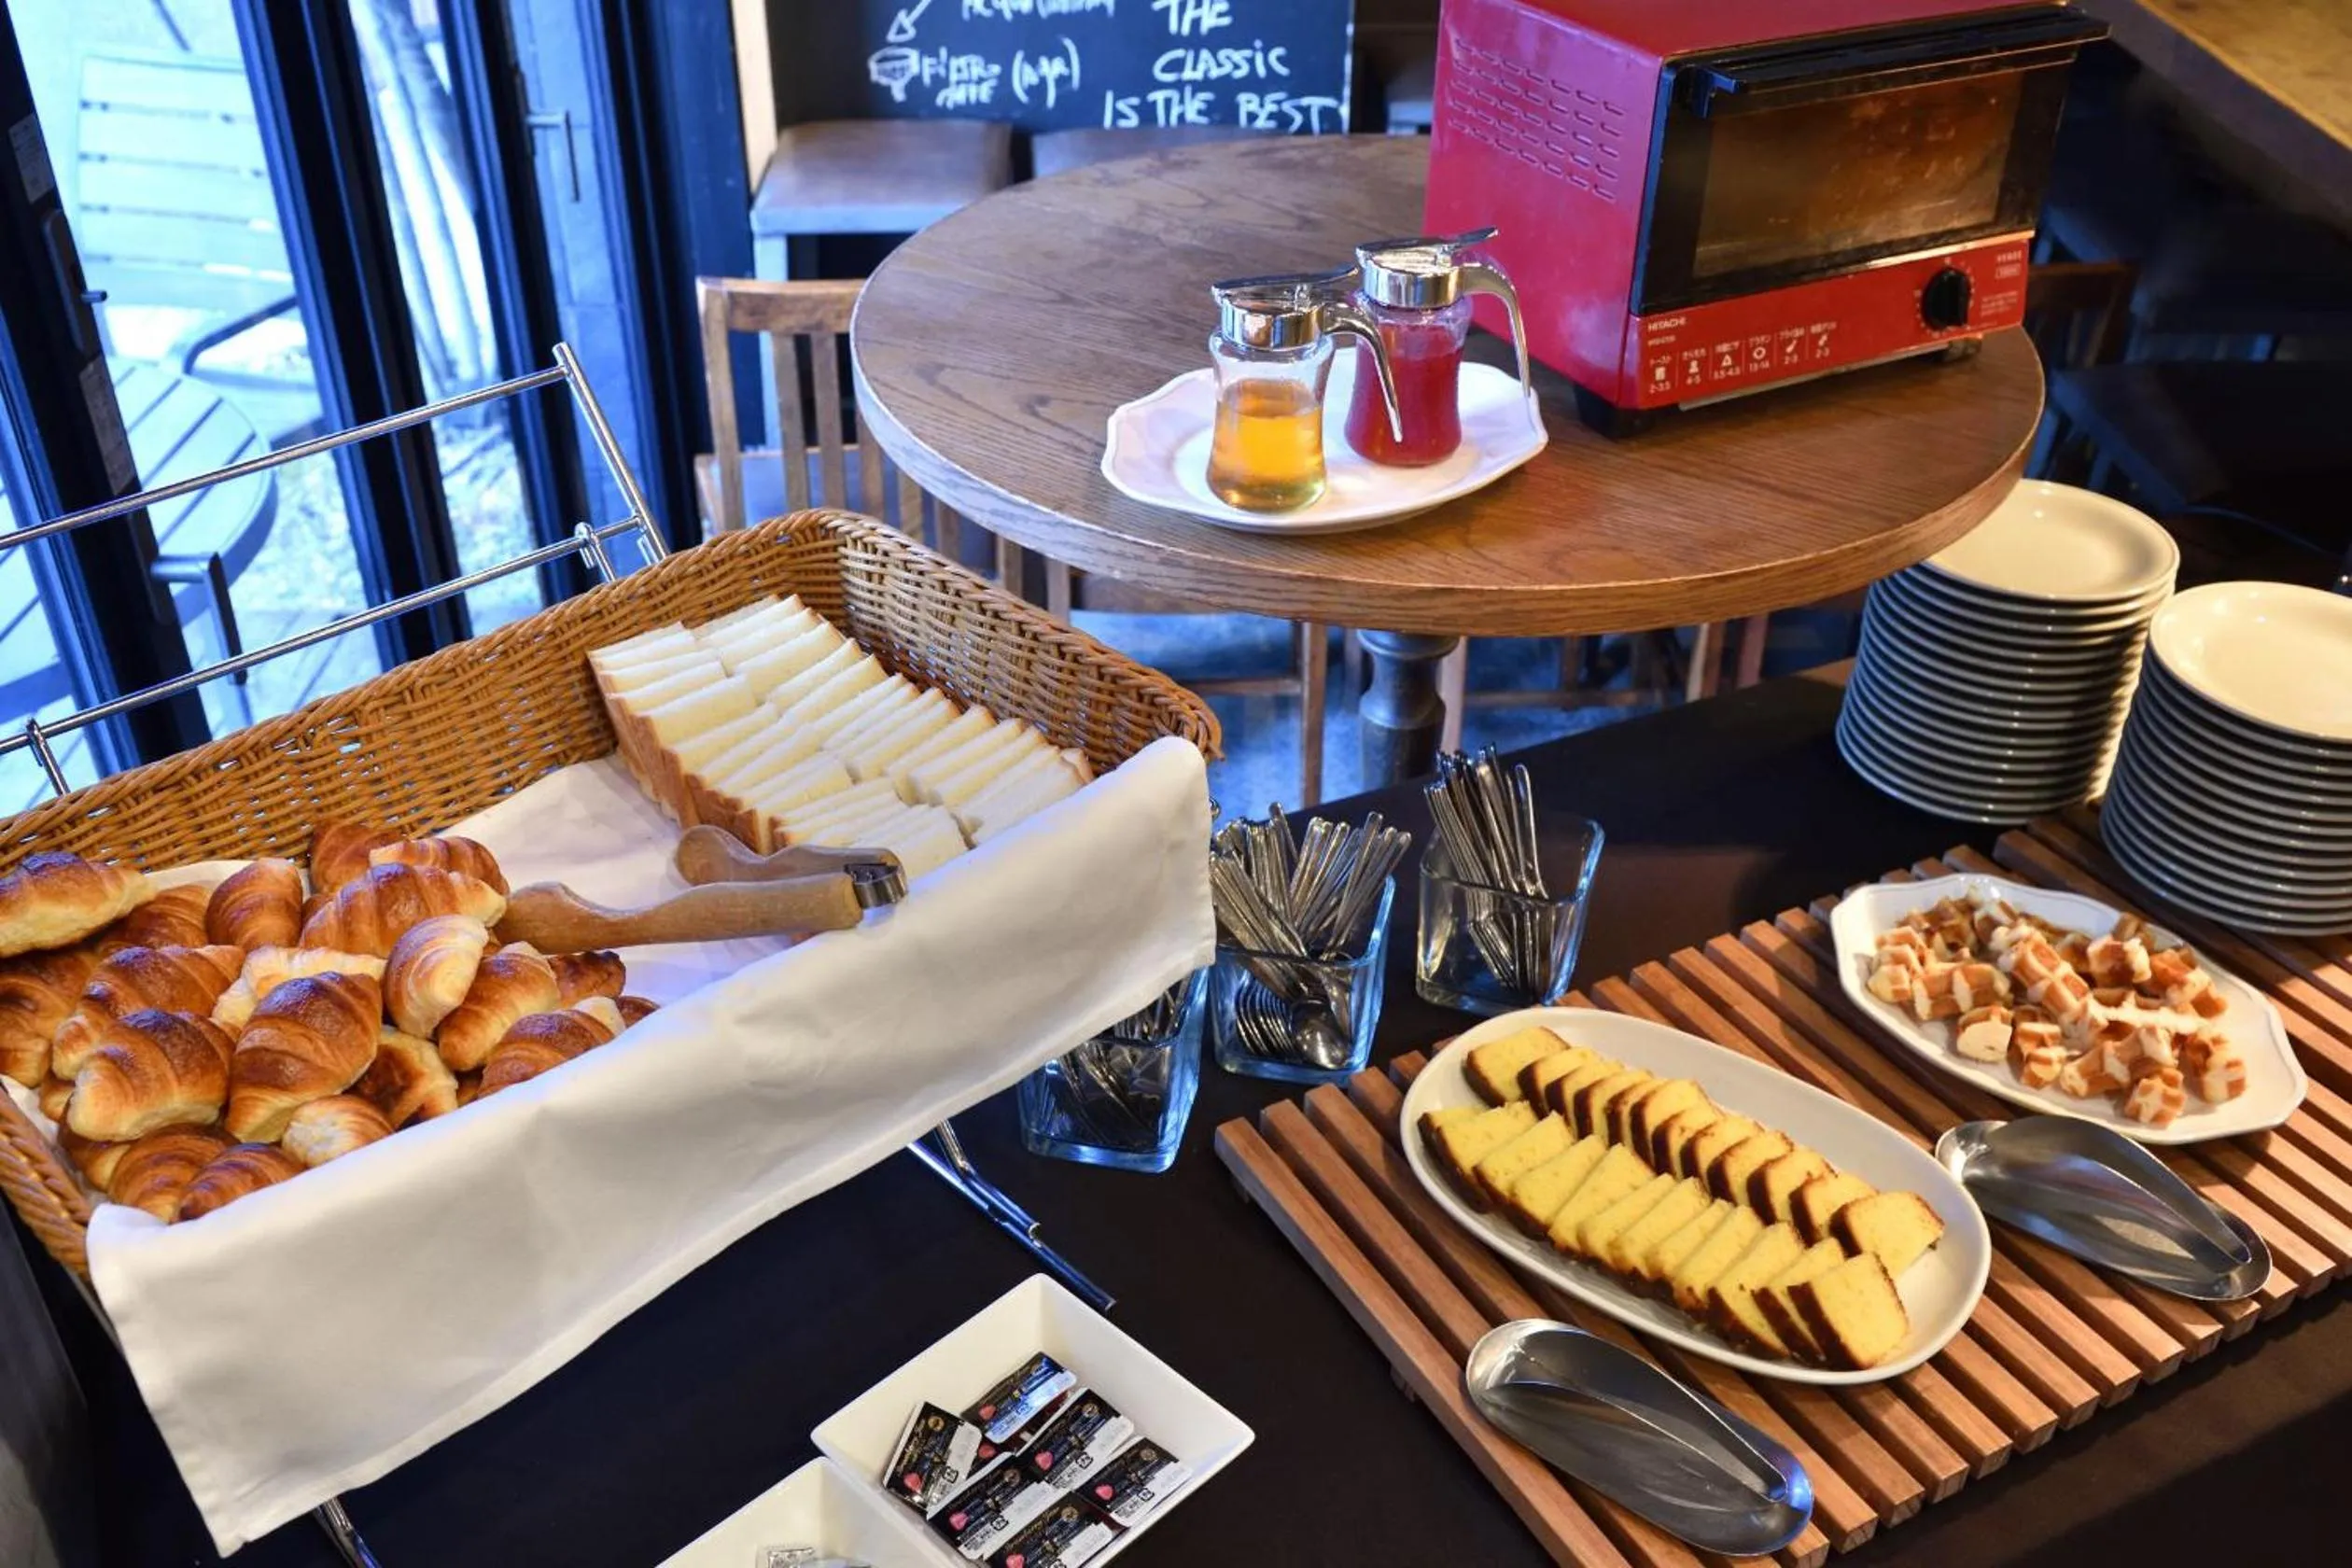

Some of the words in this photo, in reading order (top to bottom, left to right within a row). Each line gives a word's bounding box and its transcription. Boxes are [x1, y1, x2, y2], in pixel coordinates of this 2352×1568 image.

[1103, 90, 1140, 129] IS
[1146, 85, 1215, 128] THE
[1236, 91, 1338, 134] BEST
